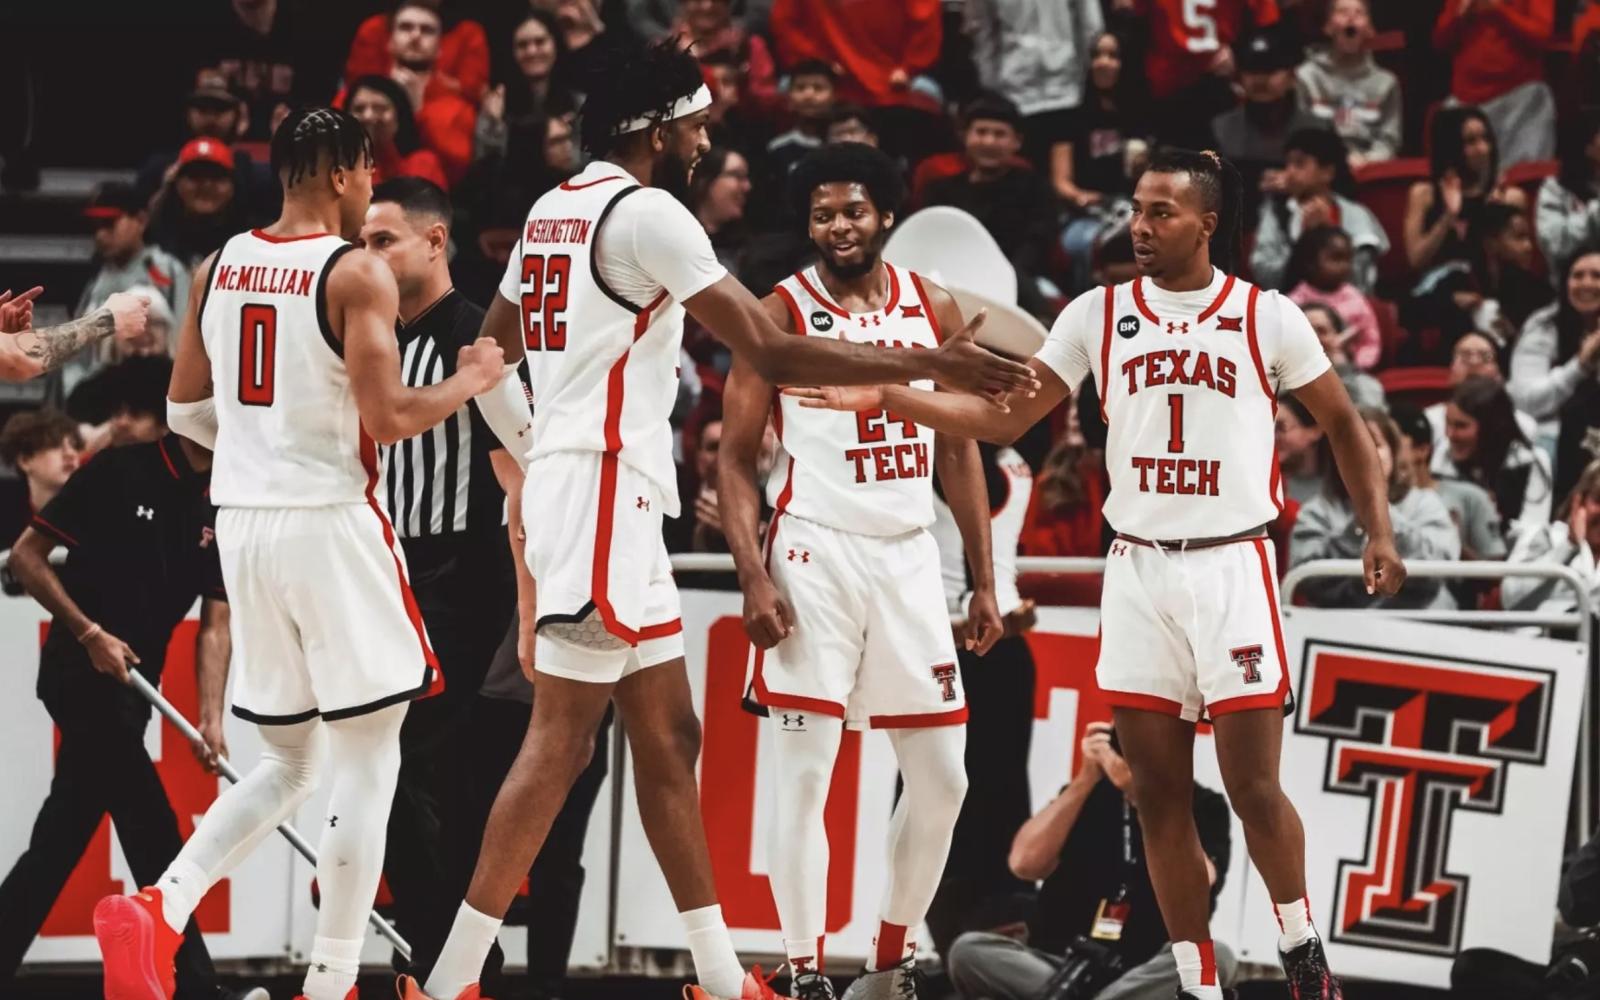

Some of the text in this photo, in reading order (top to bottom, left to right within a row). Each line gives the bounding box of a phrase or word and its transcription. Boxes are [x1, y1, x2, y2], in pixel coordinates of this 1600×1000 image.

[215, 265, 315, 297] McMILLIAN
[520, 254, 572, 351] 22
[813, 316, 831, 326] BK
[1119, 320, 1138, 332] BK
[238, 303, 277, 408] 0
[1121, 349, 1237, 399] TEXAS
[1167, 393, 1185, 453] 1
[845, 442, 929, 483] TECH
[1131, 456, 1221, 497] TECH
